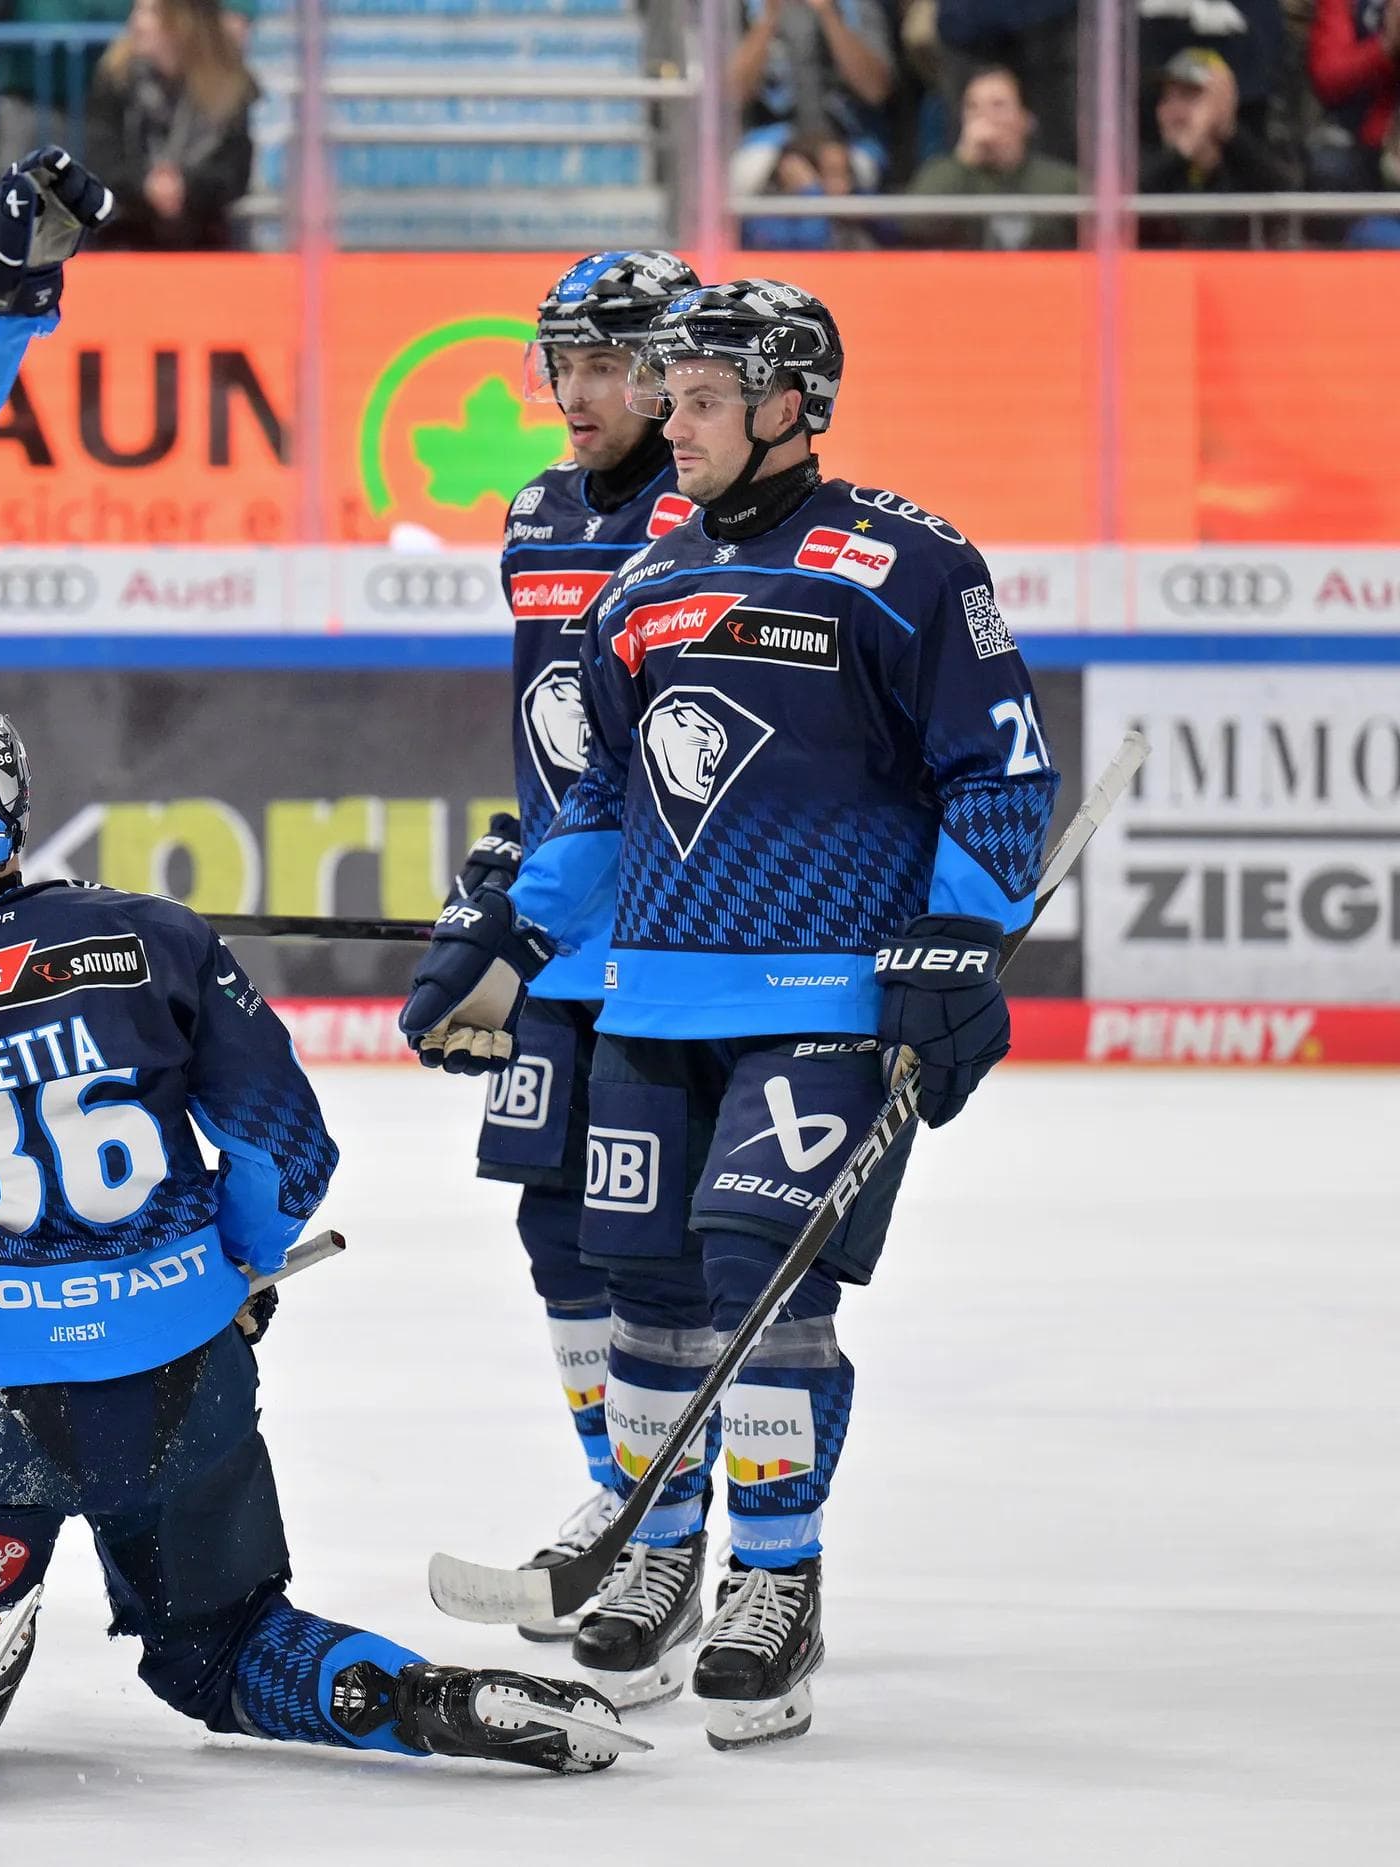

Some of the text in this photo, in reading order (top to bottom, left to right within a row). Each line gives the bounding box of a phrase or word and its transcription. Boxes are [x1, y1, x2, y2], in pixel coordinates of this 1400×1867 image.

[784, 359, 813, 367] BAUER
[512, 521, 554, 541] Bayern
[120, 570, 255, 606] Audi
[622, 559, 676, 592] Bayern
[1314, 569, 1400, 605] Au
[760, 624, 829, 655] SATURN
[1124, 866, 1400, 947] ZIEG
[69, 949, 139, 977] SATURN
[780, 974, 850, 988] BAUER
[793, 1038, 882, 1058] BAUE
[585, 1138, 645, 1200] DB
[49, 1320, 107, 1343] JER53Y
